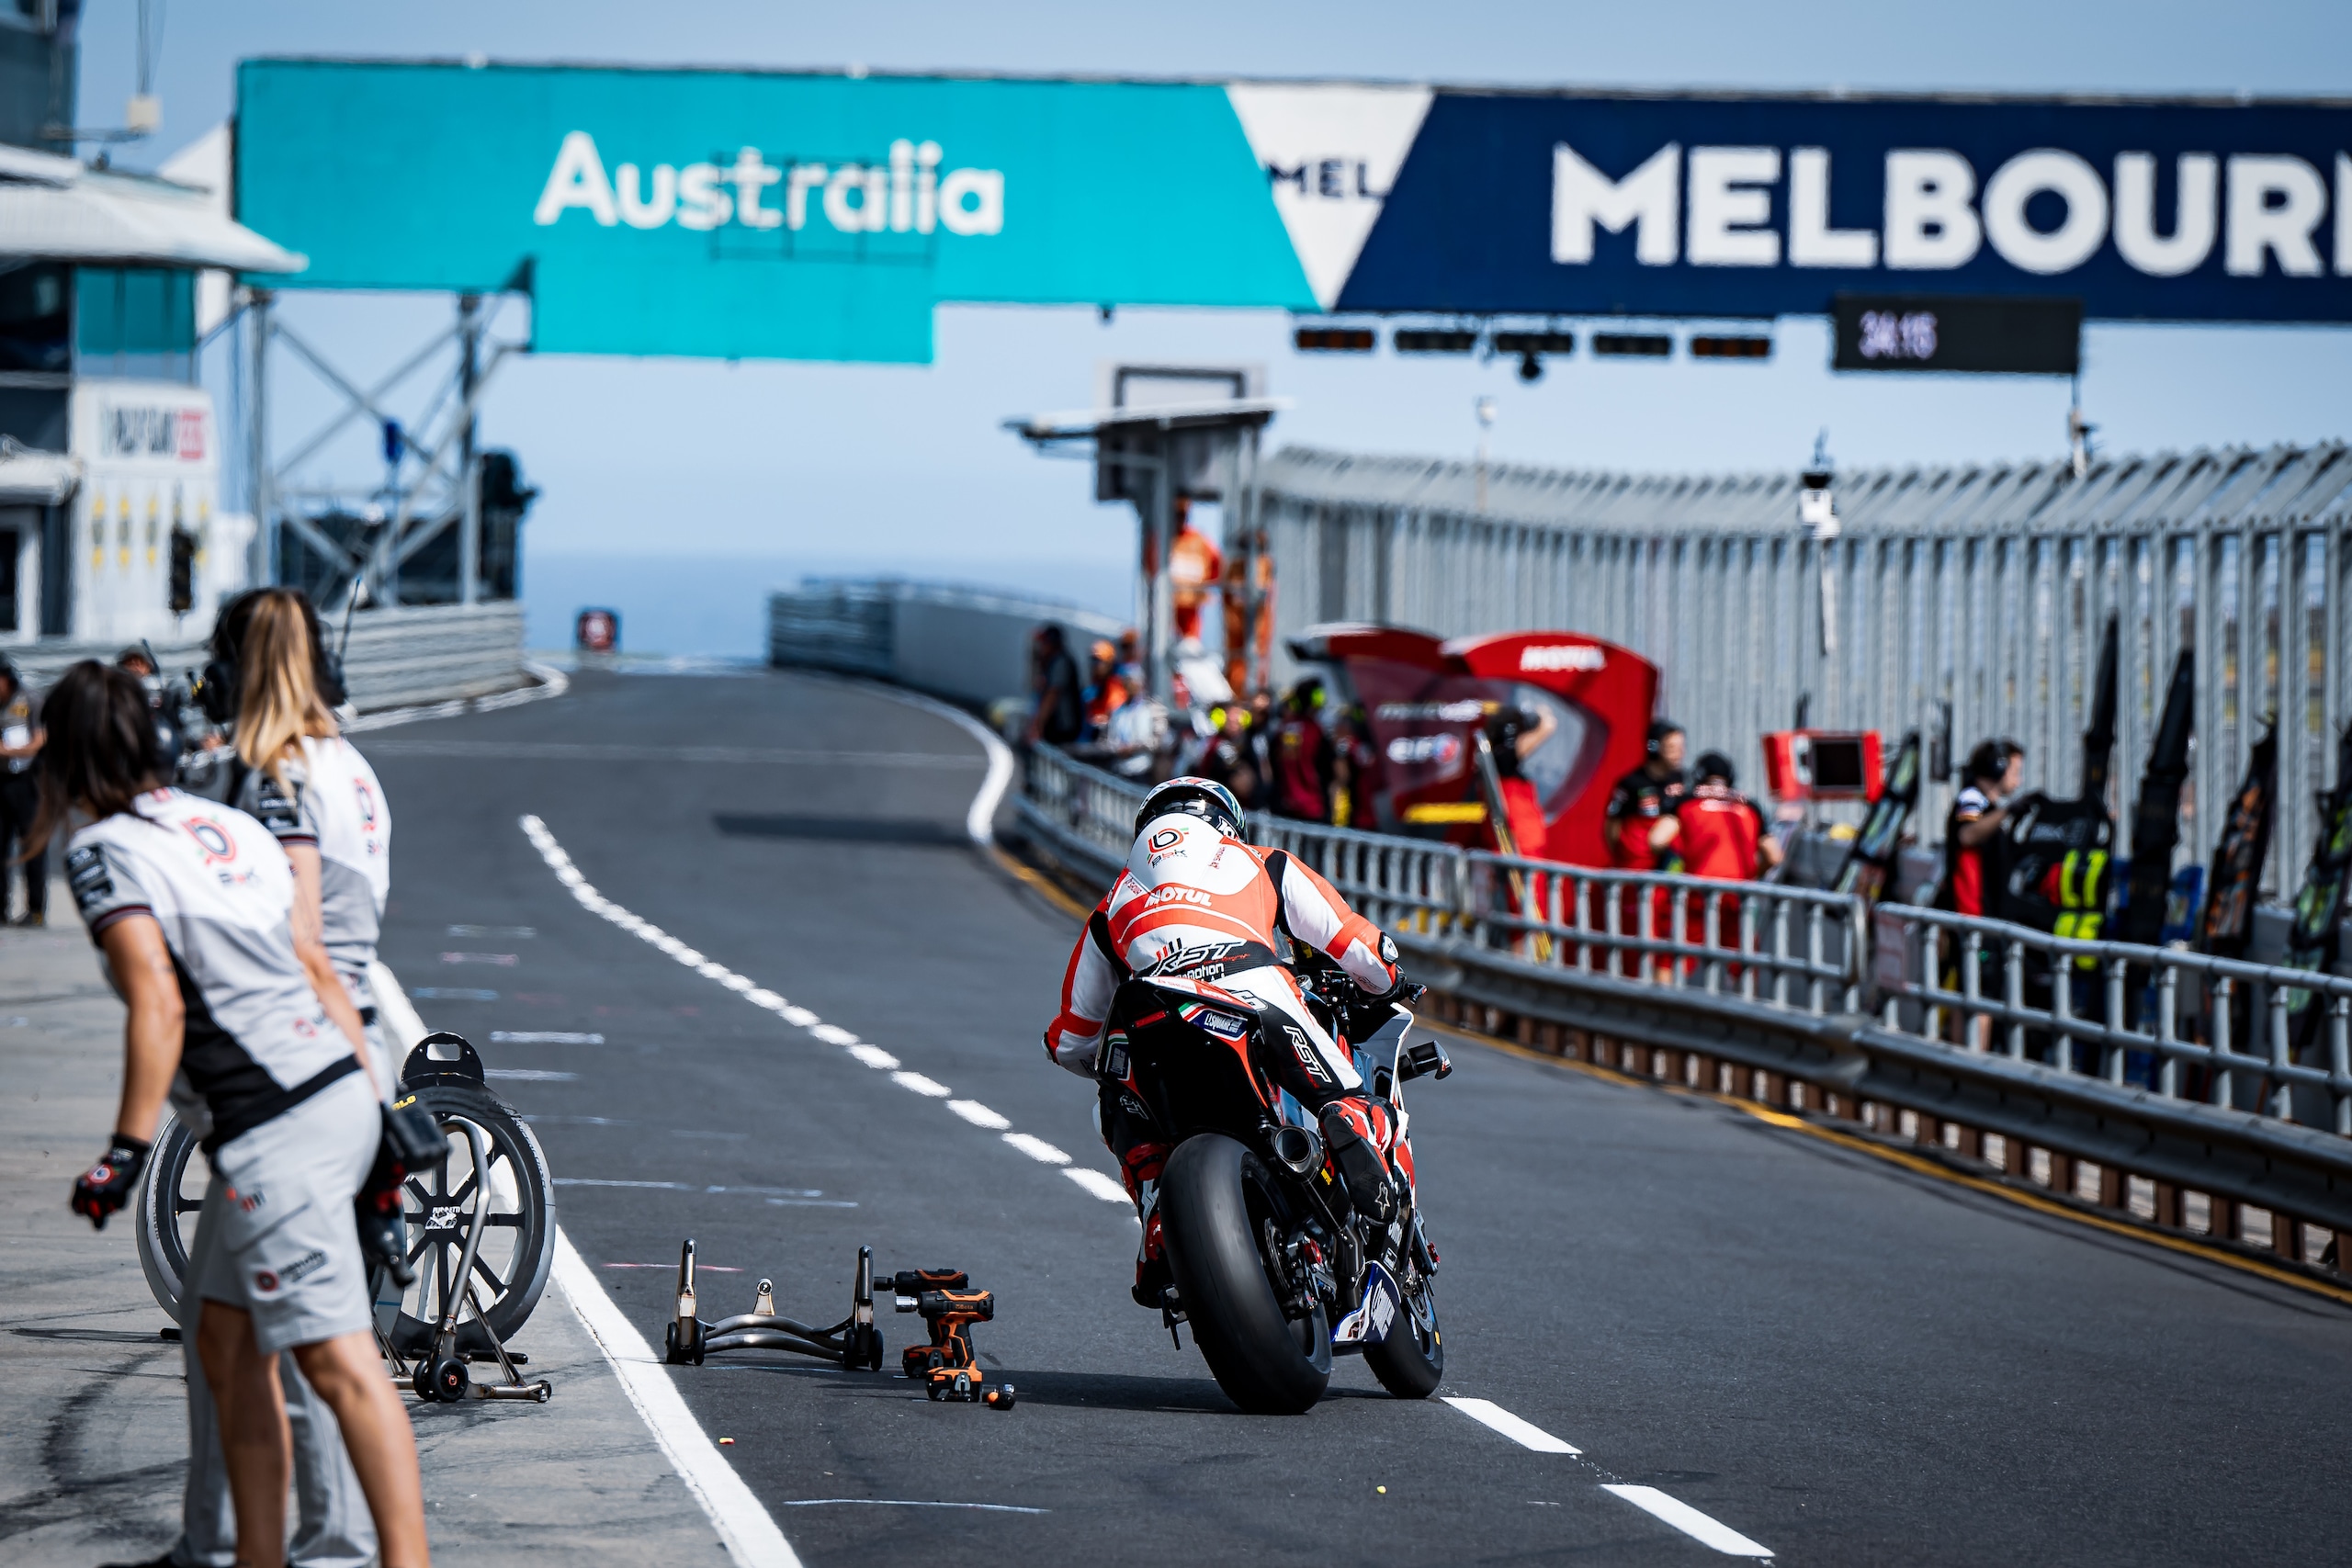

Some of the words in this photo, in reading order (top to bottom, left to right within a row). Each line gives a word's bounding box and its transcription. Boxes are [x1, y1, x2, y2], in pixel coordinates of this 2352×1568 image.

[533, 130, 1005, 236] Australia
[1265, 158, 1385, 198] MEL
[1550, 140, 2352, 277] MELBOUR
[1144, 886, 1212, 908] MOTUL
[1149, 940, 1247, 977] RST
[1283, 1025, 1332, 1083] RST
